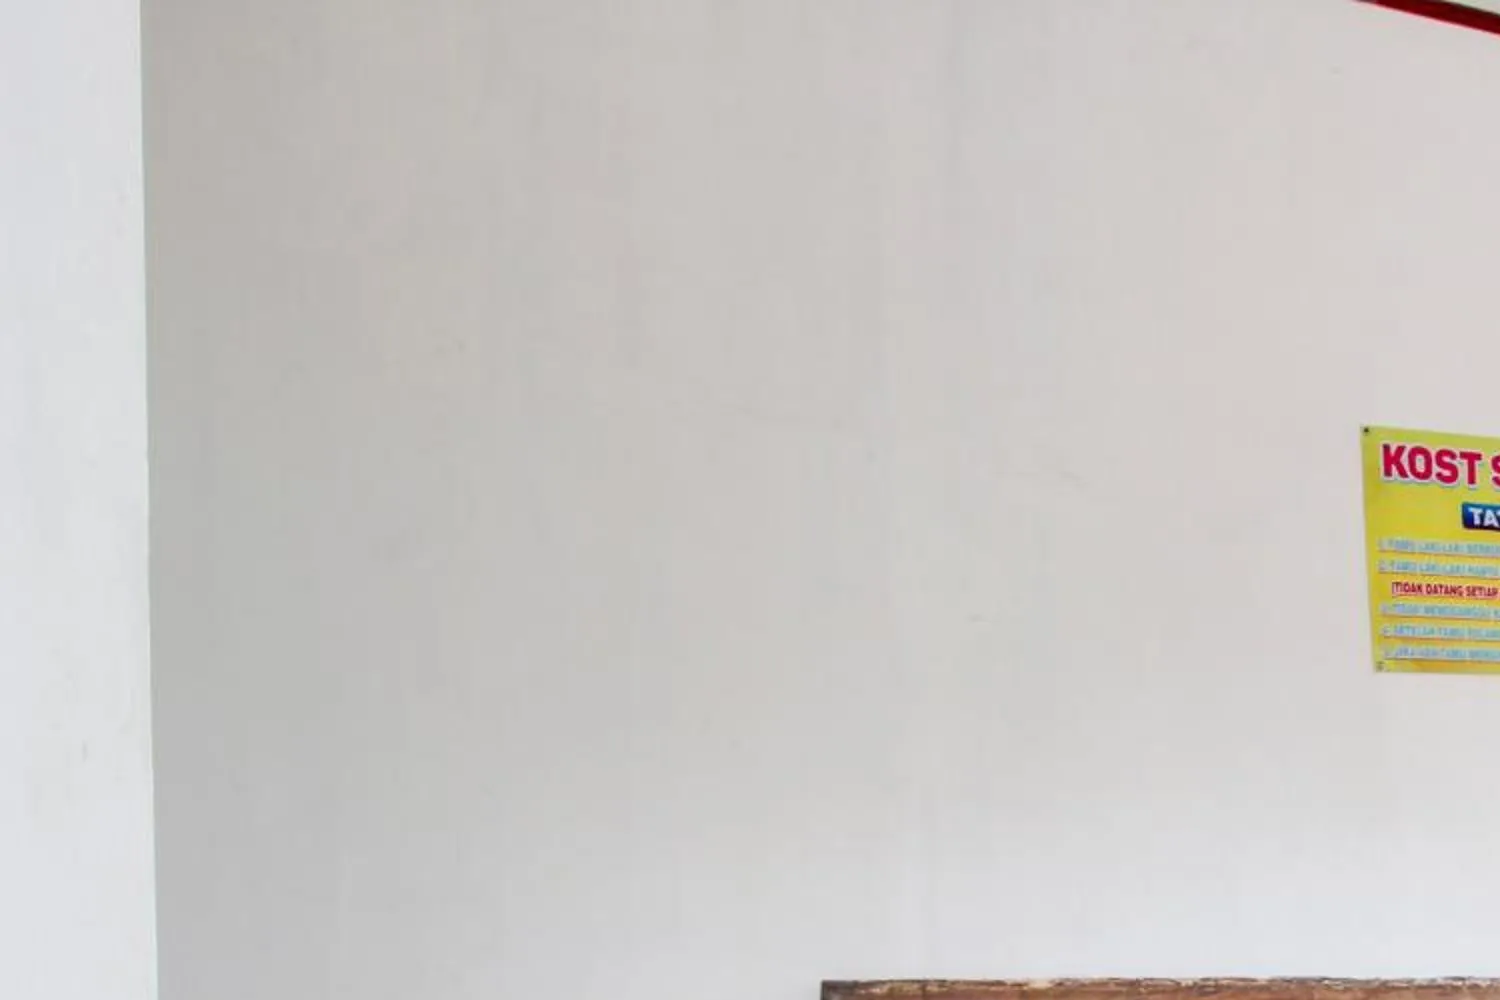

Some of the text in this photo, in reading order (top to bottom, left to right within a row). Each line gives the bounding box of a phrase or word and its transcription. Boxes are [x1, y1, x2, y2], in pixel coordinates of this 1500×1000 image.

[1381, 443, 1482, 485] KOST
[1425, 583, 1463, 597] DATANG
[1466, 585, 1499, 598] SETIAP
